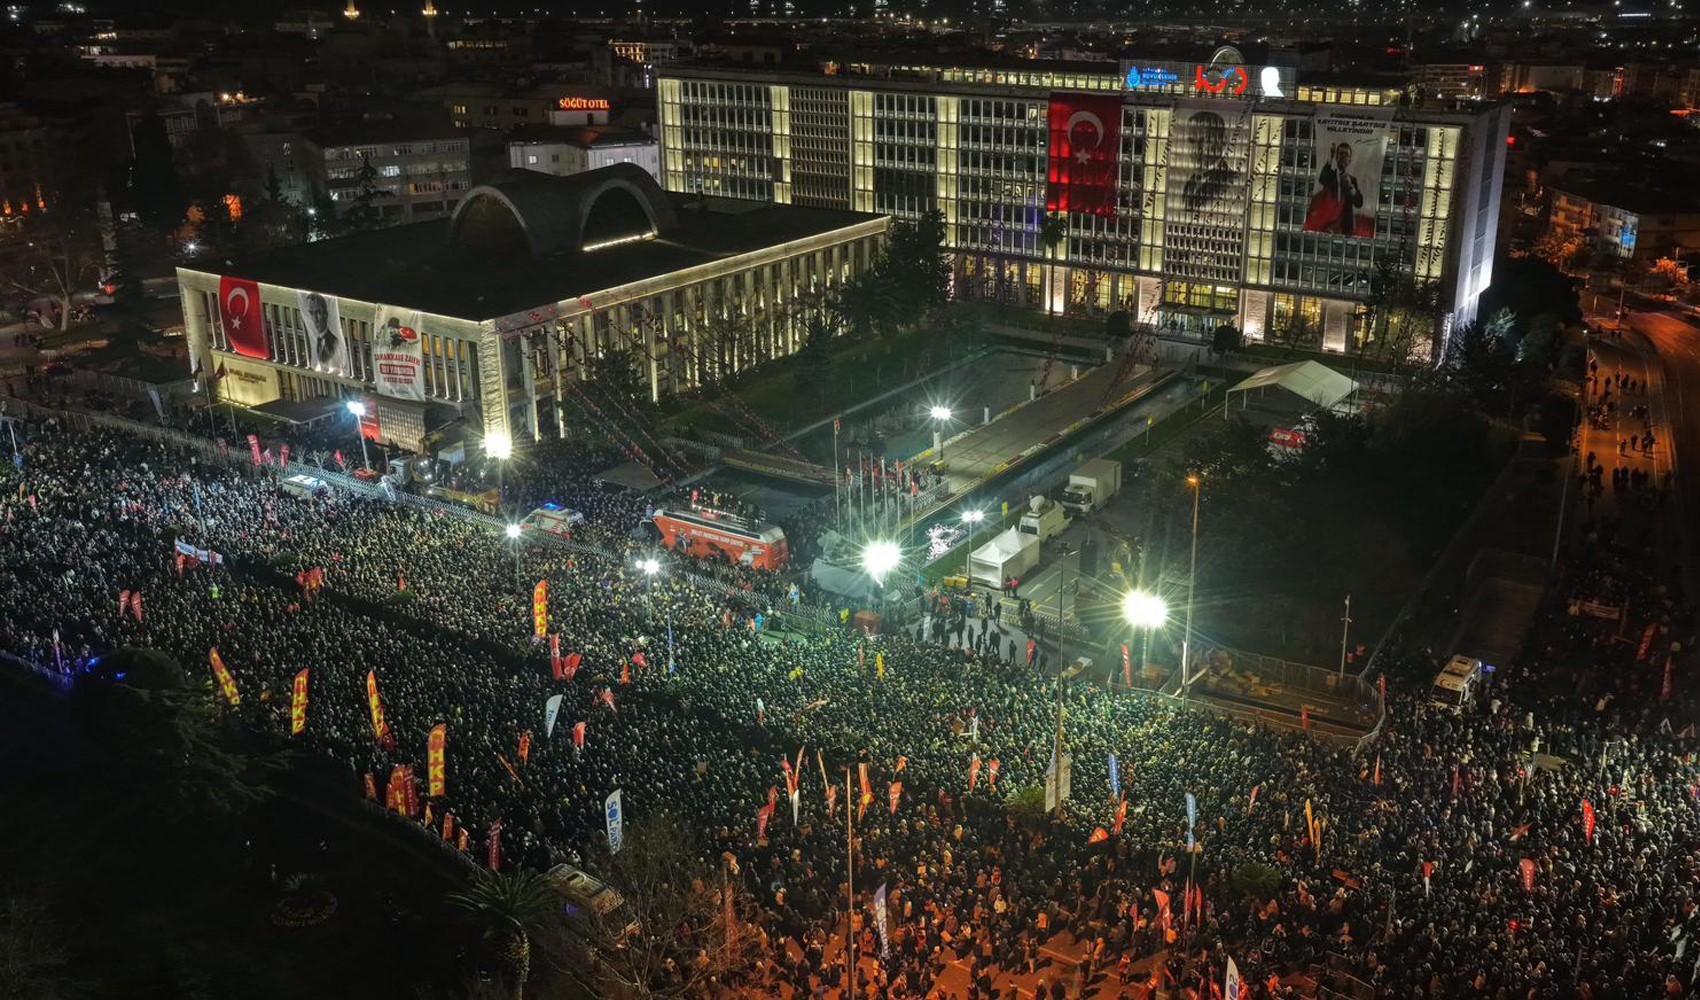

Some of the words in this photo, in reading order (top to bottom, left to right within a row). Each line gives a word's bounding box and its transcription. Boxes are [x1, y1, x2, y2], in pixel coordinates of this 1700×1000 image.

[560, 97, 587, 109] SÖĞÜT
[588, 99, 610, 109] OTEL
[607, 801, 619, 827] SOL
